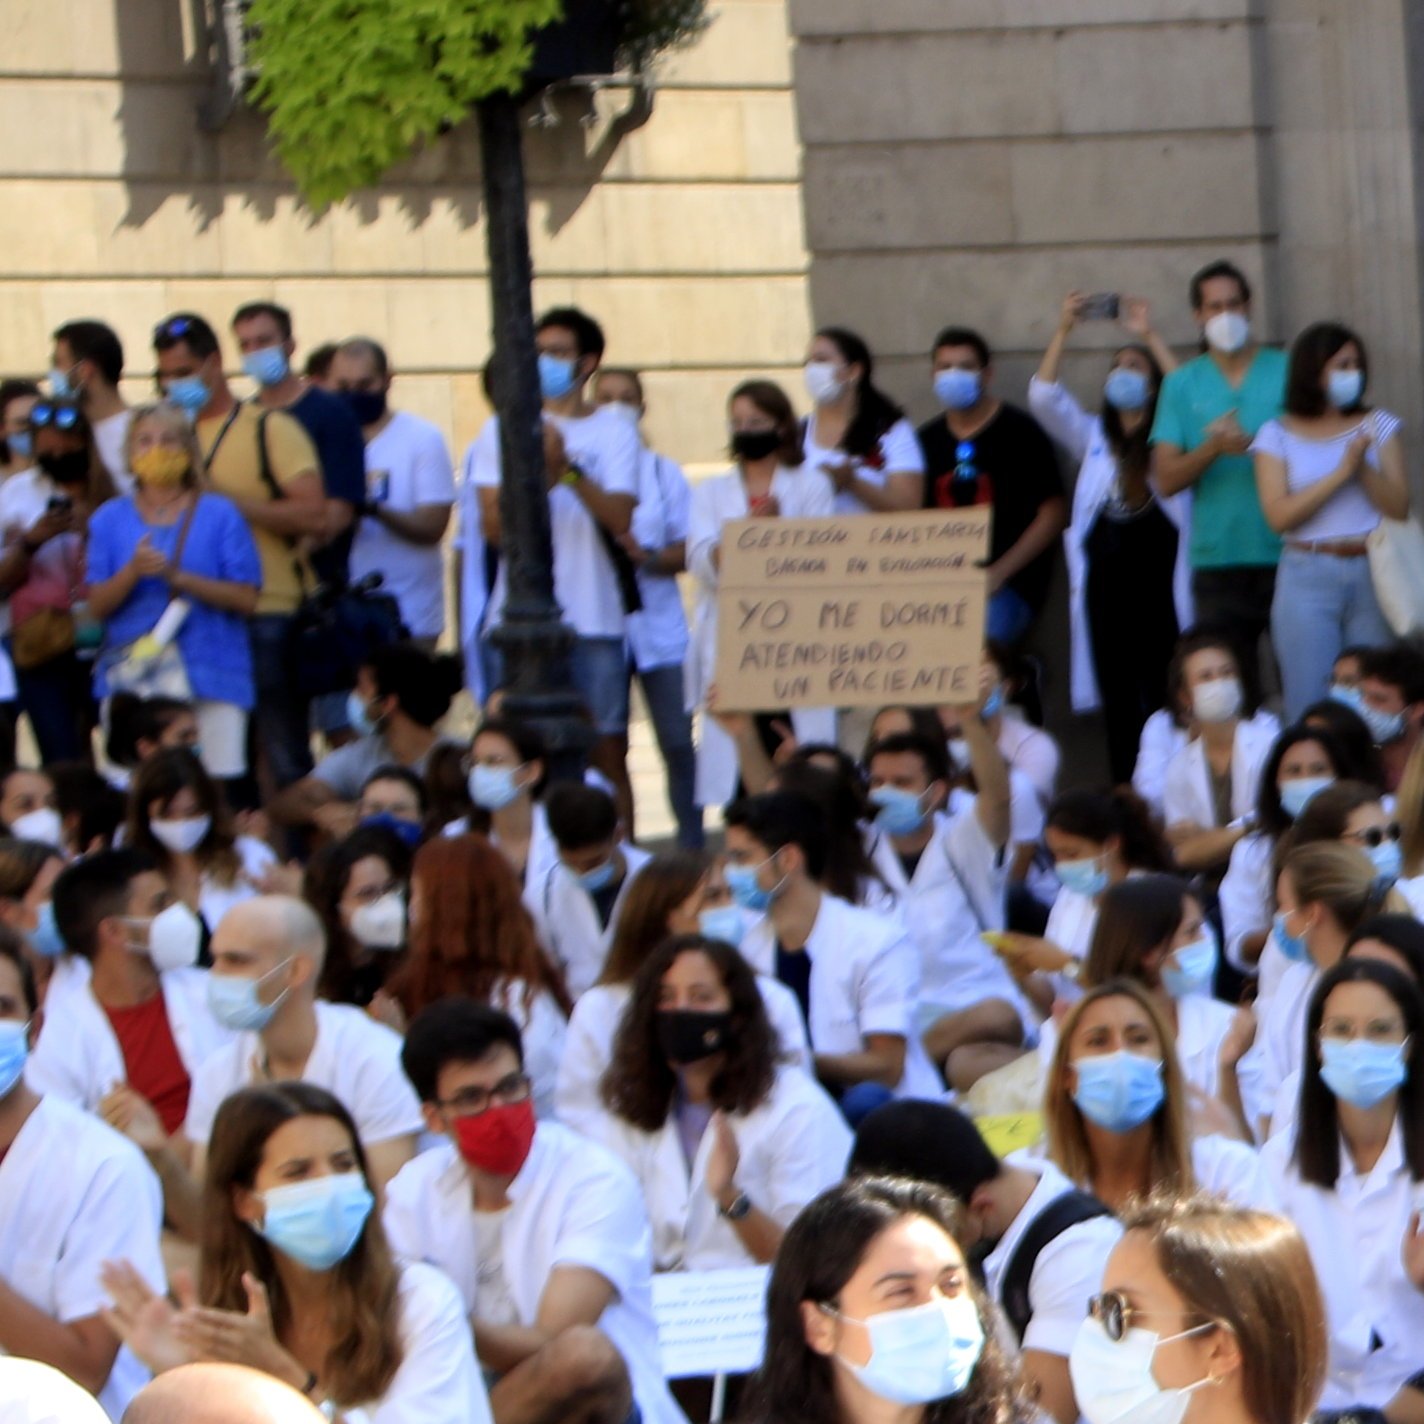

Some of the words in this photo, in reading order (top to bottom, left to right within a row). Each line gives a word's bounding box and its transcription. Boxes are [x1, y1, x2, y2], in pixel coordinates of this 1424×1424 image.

[737, 524, 849, 550] GESTIÓN
[738, 599, 791, 631] YO
[818, 601, 860, 630] ME
[879, 596, 968, 630] DORMÍ
[738, 640, 908, 672] ATENDIENDO
[774, 674, 812, 700] UN
[828, 664, 970, 692] PACIENTE
